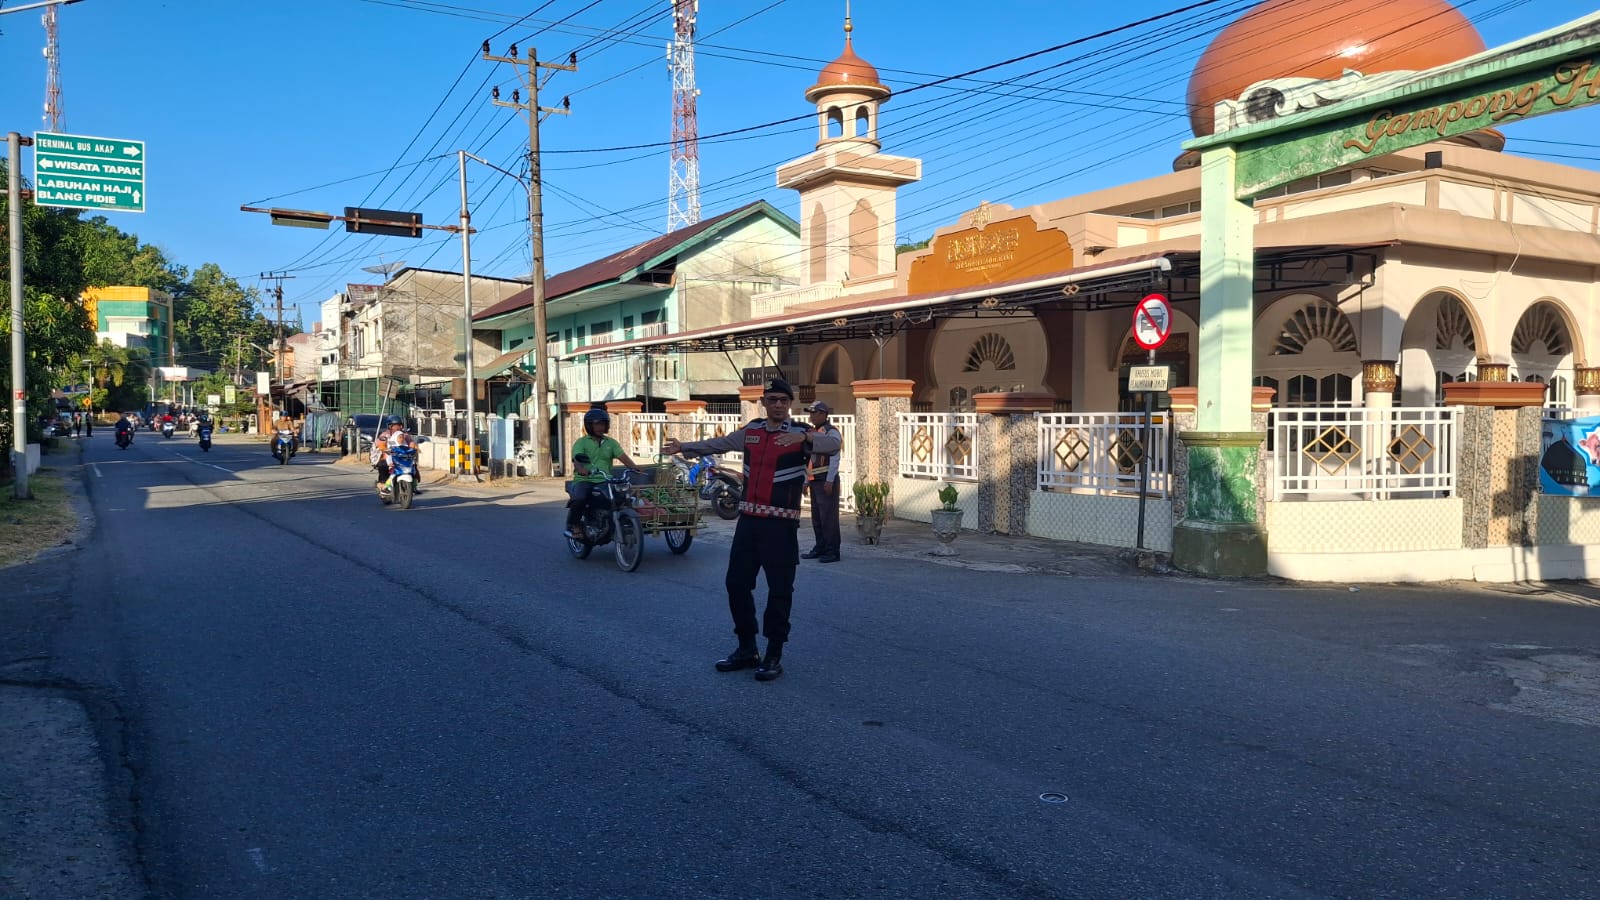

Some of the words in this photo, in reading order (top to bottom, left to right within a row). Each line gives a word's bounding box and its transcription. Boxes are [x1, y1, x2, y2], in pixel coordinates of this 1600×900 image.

[1344, 82, 1542, 152] Gampong
[38, 139, 74, 150] TERMINAL
[77, 142, 91, 152] BUS
[95, 144, 115, 154] AKAP
[54, 160, 100, 172] WISATA
[102, 164, 141, 176] TAPAK
[38, 179, 100, 191] LABUHAN
[103, 184, 132, 195] HAJI
[38, 190, 82, 202] BLANG
[85, 193, 117, 205] PIDIE
